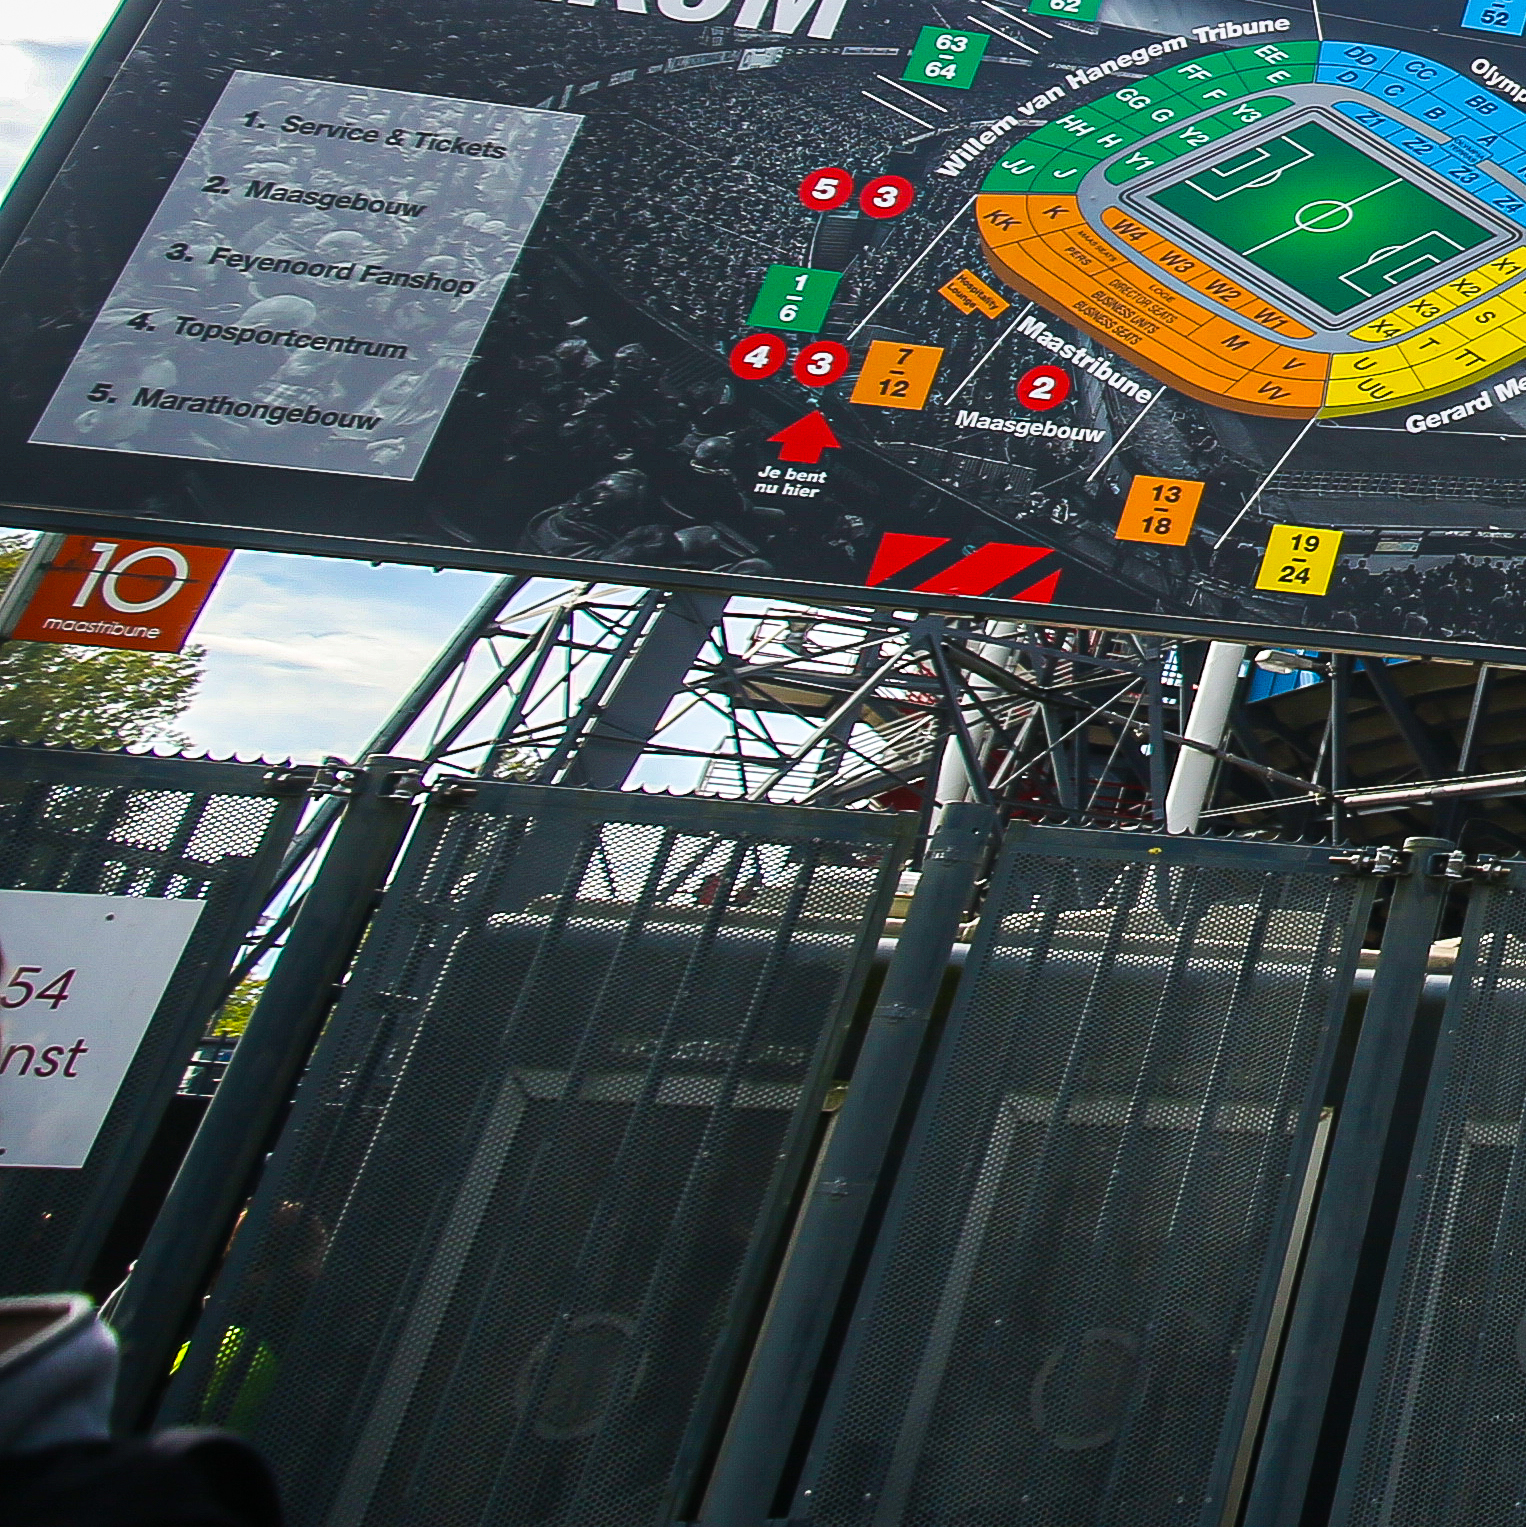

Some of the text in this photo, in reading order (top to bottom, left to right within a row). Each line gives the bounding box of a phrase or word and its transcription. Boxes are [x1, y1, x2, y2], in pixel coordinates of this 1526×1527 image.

[1480, 10, 1509, 27] 52
[935, 34, 967, 52] 63
[1254, 44, 1290, 65] EE
[1343, 45, 1379, 67] DD
[924, 61, 956, 80] 64
[1177, 63, 1212, 82] FF
[1335, 70, 1359, 84] D
[1404, 59, 1438, 82] CC
[936, 16, 1290, 178] Willem van Hanegem Tribune
[1115, 88, 1151, 111] GG
[1202, 88, 1228, 102] F
[1383, 84, 1405, 99] C
[1232, 103, 1263, 123] Y3
[1423, 107, 1446, 122] B
[1464, 95, 1498, 116] BB
[1056, 114, 1095, 138] HH
[1150, 108, 1175, 124] G
[1356, 112, 1386, 129] Z1
[244, 110, 508, 161] 1. Service & Tickets
[1096, 133, 1123, 149] H
[1177, 127, 1210, 146] Y2
[1477, 135, 1498, 147] A
[1402, 138, 1434, 156] Z2
[1001, 158, 1035, 175] JJ
[1125, 151, 1155, 171] Y1
[1053, 167, 1078, 179] J
[1448, 166, 1477, 184] Z3
[201, 176, 427, 219] 2. Maasgebouw
[812, 178, 899, 208] 5 3
[1043, 205, 1070, 220] K
[1494, 196, 1523, 214] Z4
[983, 209, 1022, 232] KK
[1112, 219, 1148, 241] W4
[1064, 246, 1092, 266] PERS
[1159, 250, 1195, 273] W3
[165, 242, 476, 297] 3. Feyenoord Fanshop
[1491, 258, 1521, 275] X1
[795, 275, 809, 291] 1
[957, 275, 999, 310] Hospitality
[1204, 279, 1243, 303] W2
[1449, 278, 1482, 297] X2
[947, 283, 976, 308] Lounge
[1108, 278, 1178, 324] DIRECTOR SEATS
[1148, 284, 1176, 303] LOGE
[779, 304, 798, 322] 6
[1091, 290, 1160, 334] BUSINESS UNITS
[1408, 298, 1441, 318] X3
[1474, 311, 1497, 324] S
[1072, 300, 1143, 345] BUSINESS SEATS
[1253, 307, 1290, 331] W1
[1368, 319, 1402, 338] X4
[127, 313, 408, 360] 4. Topsportcentrum
[1220, 335, 1250, 351] M
[1418, 337, 1442, 351] T
[744, 346, 833, 375] 4 3
[897, 348, 915, 365] 7
[1017, 315, 1153, 406] Maastribune
[1282, 357, 1306, 371] V
[1353, 357, 1379, 371] U
[1455, 349, 1488, 367] TT
[879, 379, 910, 397] 12
[1029, 377, 1056, 401] 2
[1356, 377, 1394, 400] UU
[87, 383, 384, 432] 5. Marathongebouw
[1405, 393, 1490, 434] Gerard
[954, 410, 1106, 444] Maasgebouw
[758, 465, 827, 483] Je bent
[754, 483, 820, 499] nu hier
[1151, 485, 1182, 504] 13
[1141, 516, 1173, 537] 18
[1289, 534, 1321, 554] 19
[72, 541, 190, 614] 10
[1277, 566, 1311, 586] 24
[42, 617, 162, 639] maastribune
